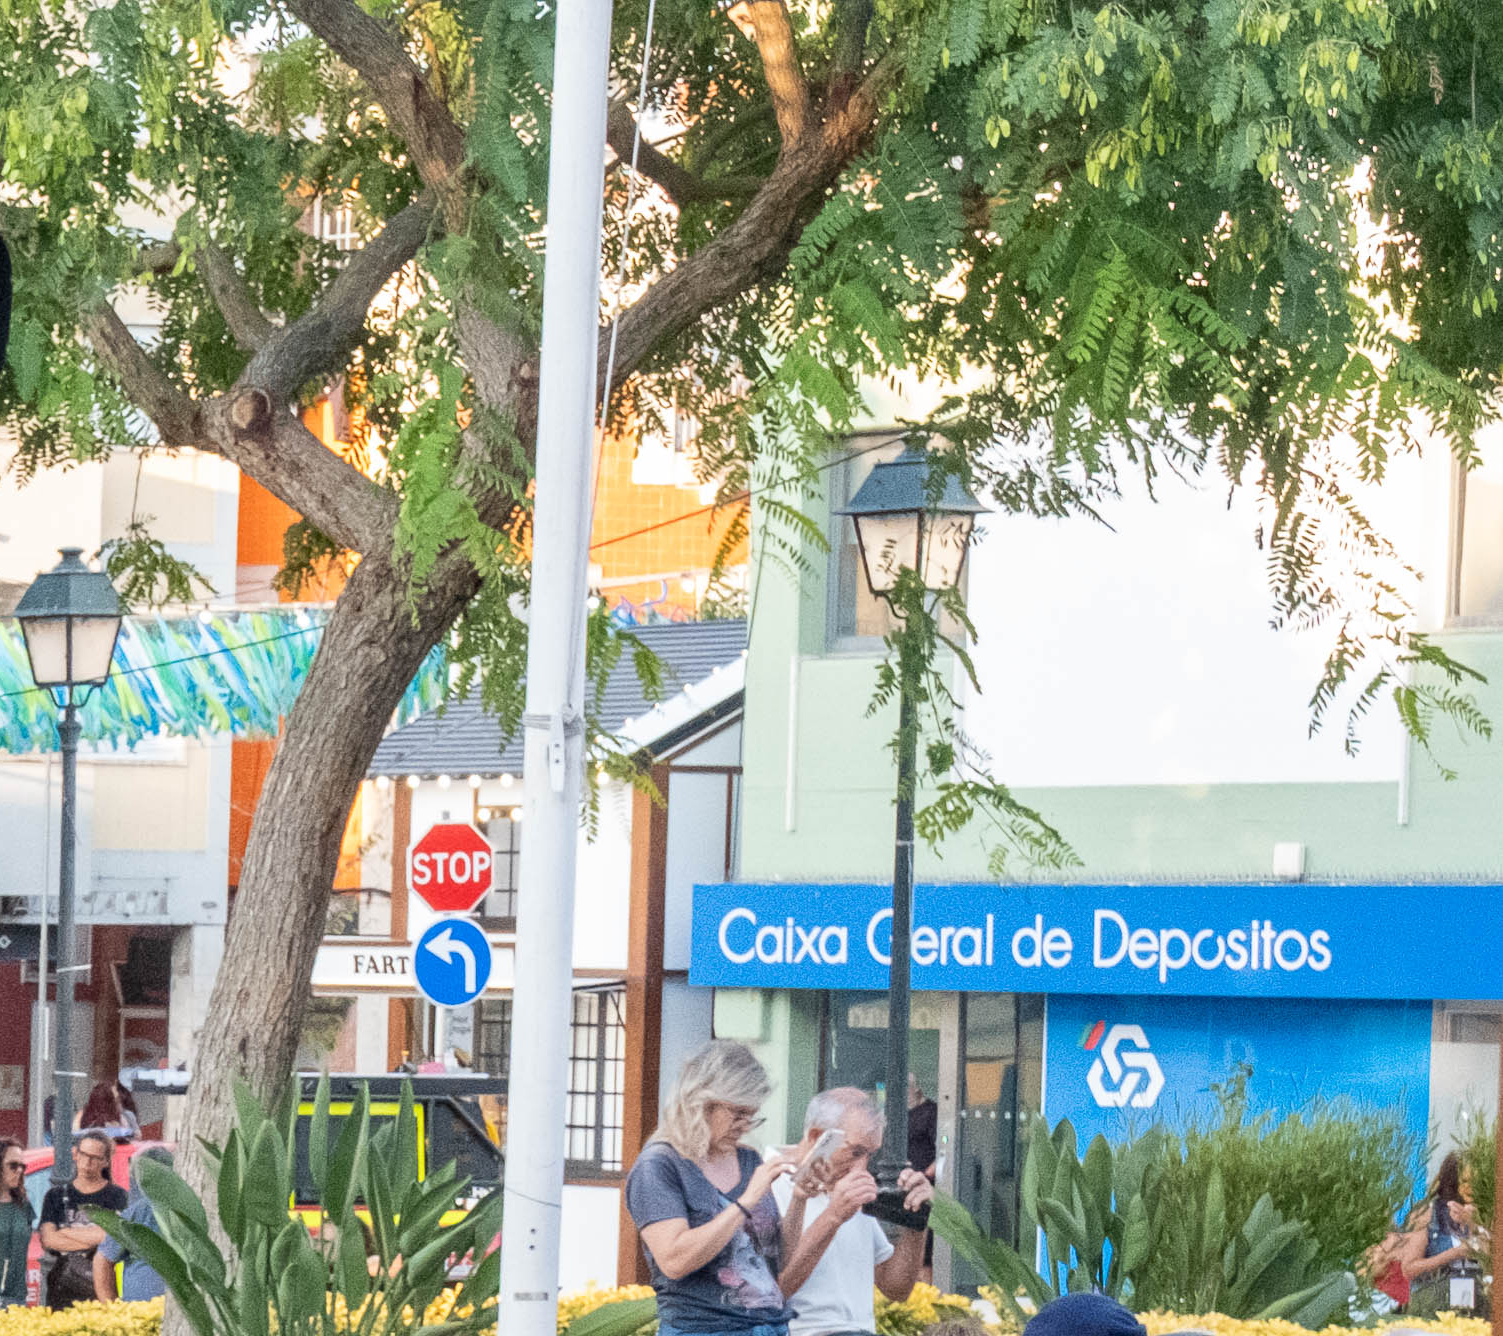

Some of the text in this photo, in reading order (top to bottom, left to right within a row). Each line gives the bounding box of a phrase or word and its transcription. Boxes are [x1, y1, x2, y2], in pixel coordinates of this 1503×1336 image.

[412, 850, 491, 885] STOP
[717, 907, 849, 965] Caixa
[1011, 913, 1073, 968] de
[353, 954, 411, 975] FART
